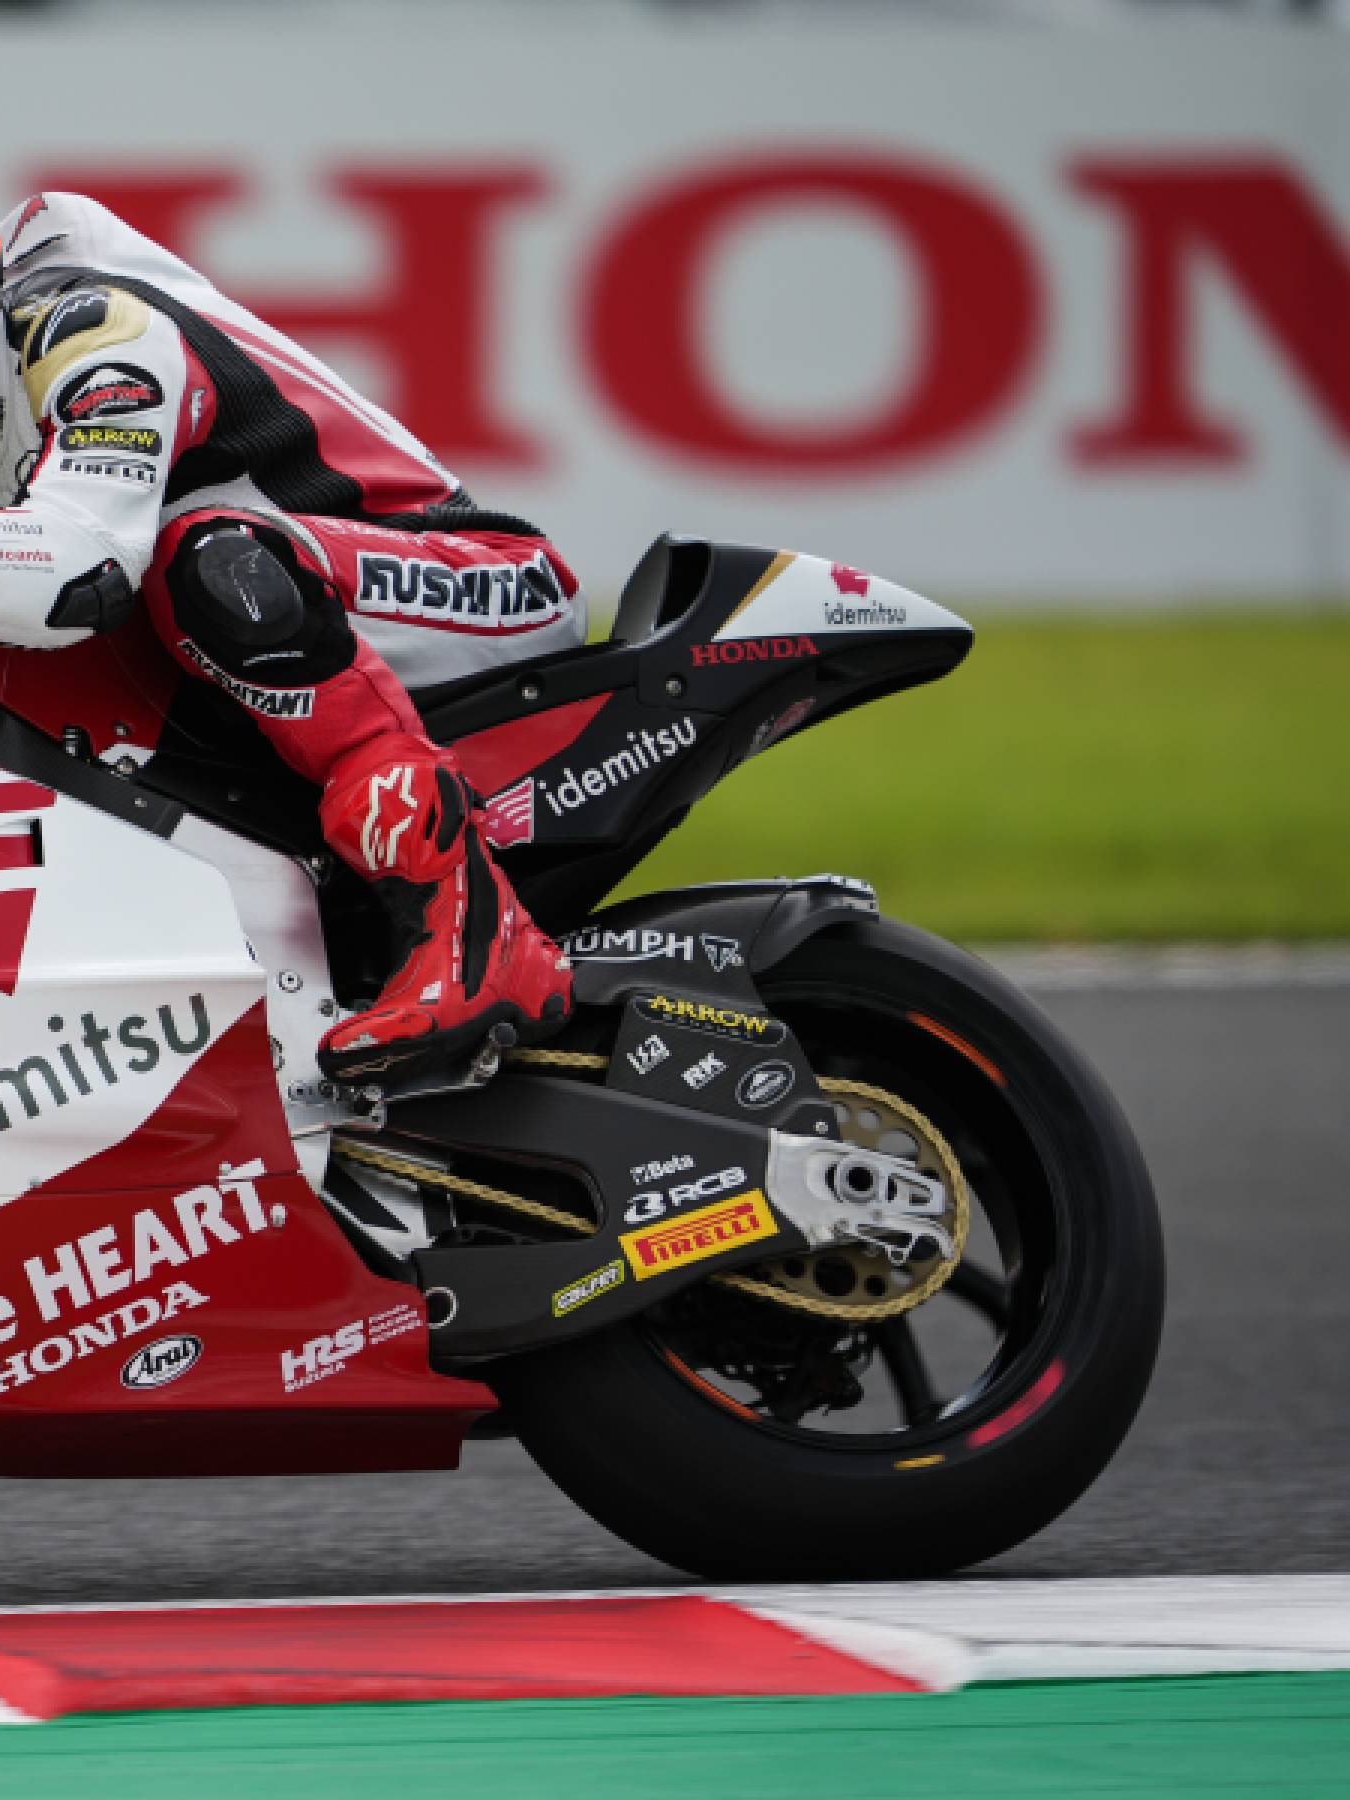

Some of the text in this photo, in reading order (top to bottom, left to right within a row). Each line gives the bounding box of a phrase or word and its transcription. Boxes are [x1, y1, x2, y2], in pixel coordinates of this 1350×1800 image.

[67, 427, 158, 449] ARROW
[823, 599, 908, 627] idemitsu
[689, 635, 821, 667] HONDA
[536, 716, 698, 816] idemitsu
[646, 994, 770, 1036] ARROW
[680, 1051, 730, 1091] RK
[647, 1153, 696, 1180] Beta
[668, 1166, 748, 1208] RCB
[23, 1156, 288, 1325] HEART.
[633, 1201, 763, 1268] PIRELLI
[280, 1319, 365, 1384] HRS
